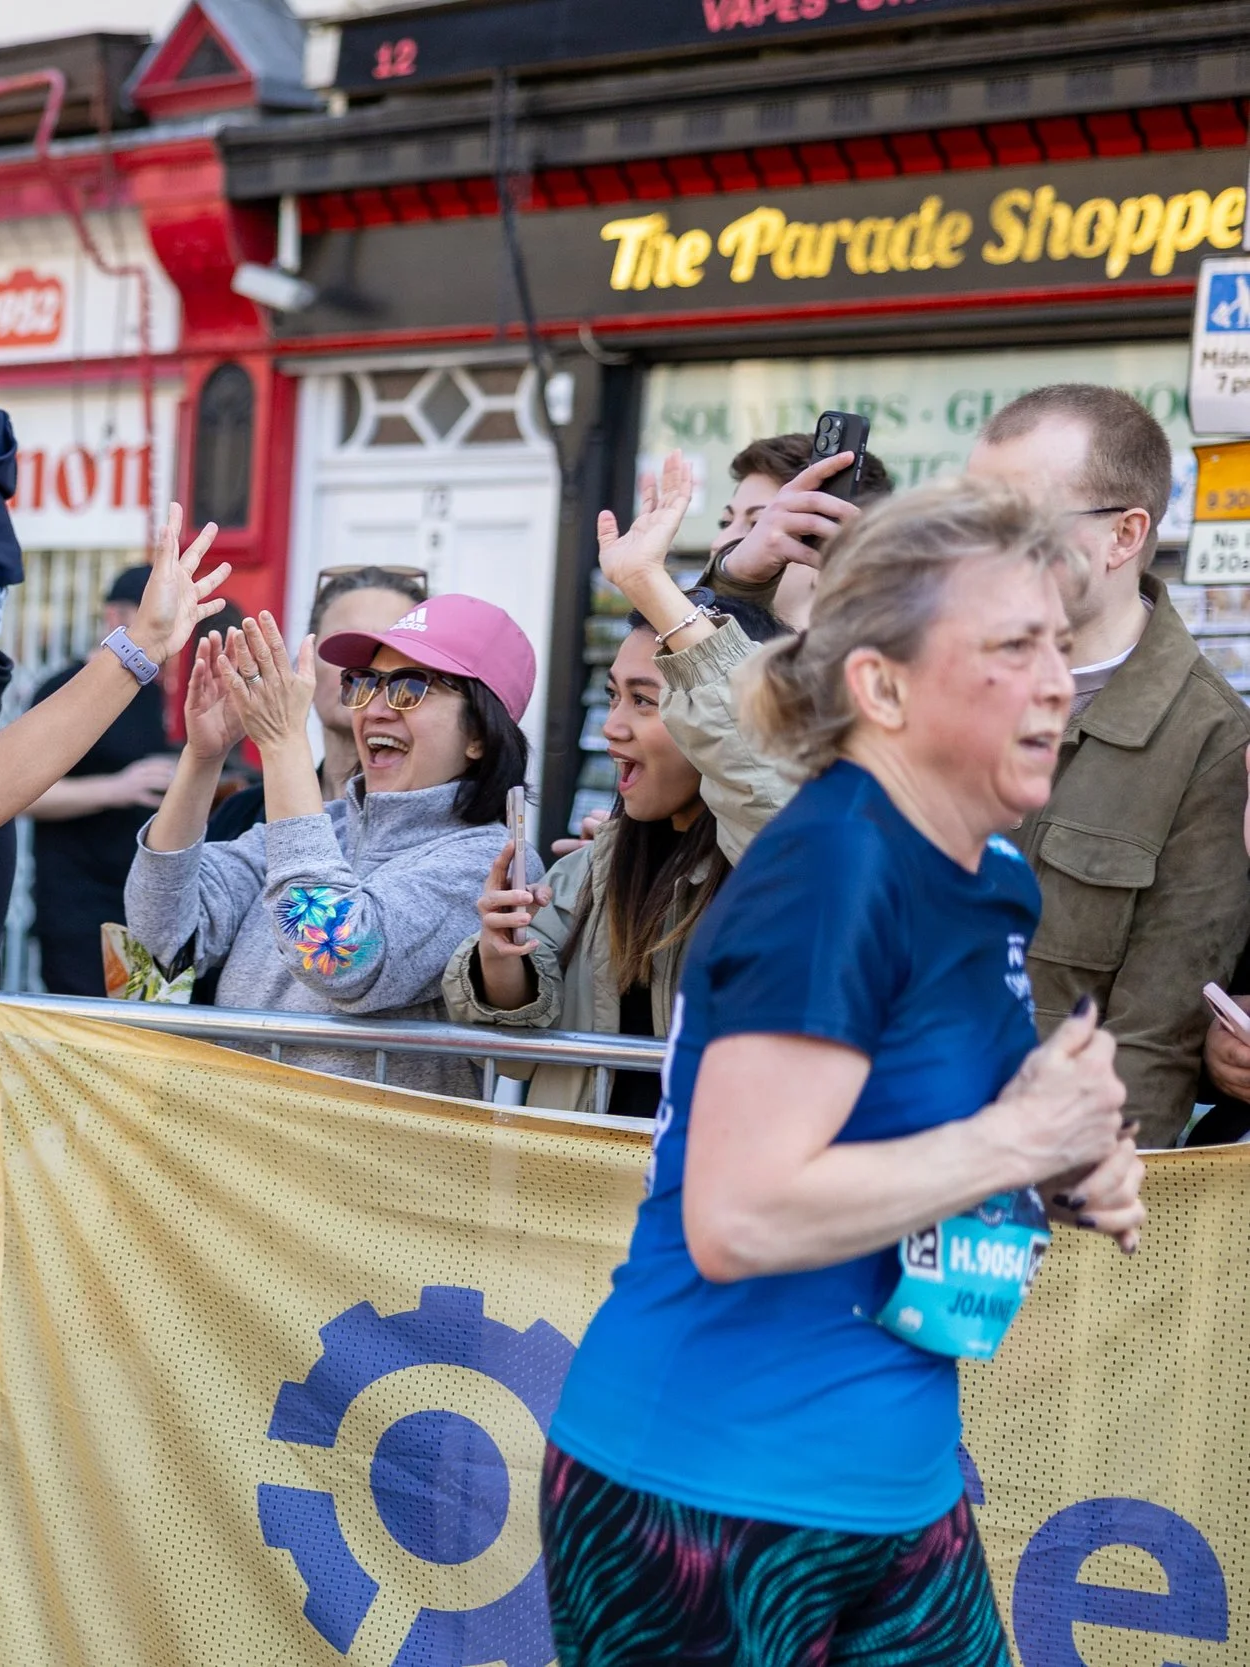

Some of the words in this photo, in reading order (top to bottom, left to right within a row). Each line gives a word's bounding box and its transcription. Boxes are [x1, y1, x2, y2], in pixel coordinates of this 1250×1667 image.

[371, 39, 417, 79] 12
[601, 213, 711, 290] The
[718, 196, 972, 282] Parade
[5, 444, 151, 517] non
